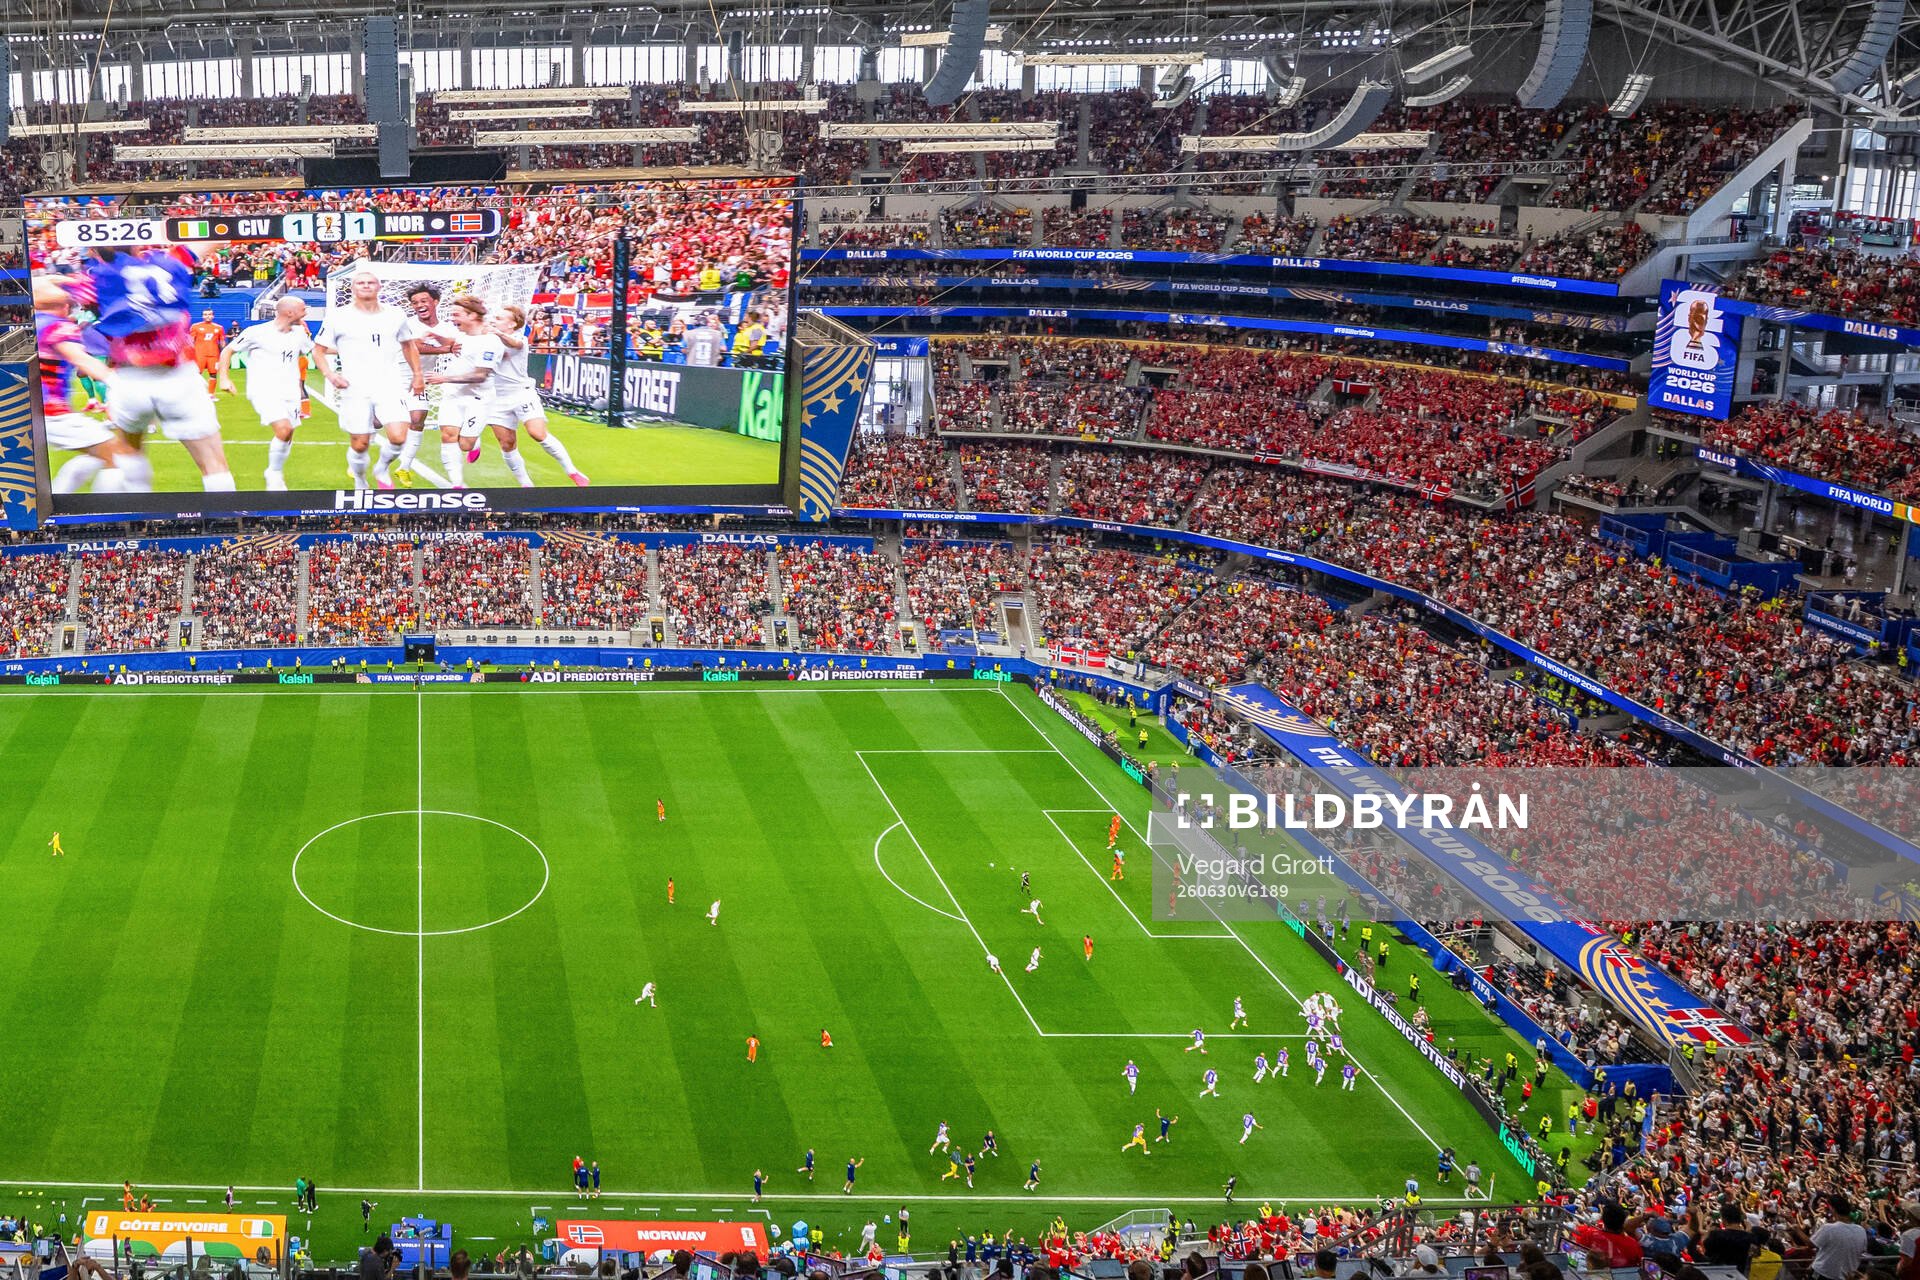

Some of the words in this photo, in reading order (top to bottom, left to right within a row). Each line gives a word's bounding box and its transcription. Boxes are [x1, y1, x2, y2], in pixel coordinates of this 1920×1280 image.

[77, 222, 153, 241] 85:26
[237, 219, 270, 236] CIV
[292, 219, 301, 235] 1
[354, 218, 364, 234] 1
[384, 216, 424, 232] NOR
[847, 250, 887, 258] DALLAS
[1012, 250, 1034, 258] FIFA
[1035, 250, 1072, 259] WORLD
[1074, 251, 1095, 259] CUP
[1096, 251, 1134, 260] 2026
[1272, 258, 1320, 268] DALLAS
[1192, 284, 1220, 292] WORLD
[1413, 299, 1468, 311] DALLAS
[1029, 309, 1068, 317] DALLAS
[1844, 321, 1898, 340] DALLAS
[877, 342, 897, 350] LAS
[1683, 351, 1705, 363] FIFA
[1668, 367, 1697, 378] WORLD
[1698, 371, 1716, 381] CUP
[552, 355, 580, 399] ADI
[579, 362, 681, 415] PREDISTREET
[1666, 376, 1715, 394] 2026
[1663, 392, 1714, 411] DALLAS
[1699, 449, 1736, 467] DALLAS
[335, 489, 487, 509] Hisense
[1828, 486, 1851, 501] FIFA
[1852, 492, 1892, 512] WORLD
[1092, 523, 1121, 531] DALLAS
[352, 533, 376, 542] FIFA
[420, 533, 443, 541] CUP
[702, 534, 778, 544] DALLAS
[67, 540, 139, 551] DALLAS
[1821, 618, 1842, 631] WORLD
[26, 674, 59, 685] Kalshi
[114, 674, 143, 685] ADI
[146, 674, 233, 684] PREDICTSTREET
[279, 673, 313, 684] Kalshi
[530, 672, 560, 682] ADI
[563, 672, 655, 682] PREDICTSTREET
[703, 671, 738, 681] Kalshi
[797, 670, 829, 680] ADI
[832, 670, 924, 680] PREDICTSTREET
[973, 669, 1011, 682] Kalshi
[1534, 656, 1546, 667] FIFA
[1546, 661, 1568, 677] WORLD
[1568, 673, 1581, 683] CUP
[1580, 680, 1603, 696] 2026
[1177, 682, 1203, 698] DALLAS
[1038, 688, 1055, 708] ADI
[1723, 752, 1757, 775] DALLAS
[1308, 747, 1360, 776] FIFA
[1419, 827, 1477, 859] CUP
[1460, 858, 1562, 923] 2026
[1277, 900, 1305, 939] Kalshi
[1472, 976, 1491, 999] FIFA
[1343, 967, 1373, 1003] ADI
[1373, 994, 1466, 1091] PREDICTSTREET
[1499, 1121, 1536, 1178] Kalshi
[119, 1218, 161, 1231] CÔTE
[161, 1220, 229, 1233] D'IVOIRE
[636, 1230, 707, 1241] NORWAY
